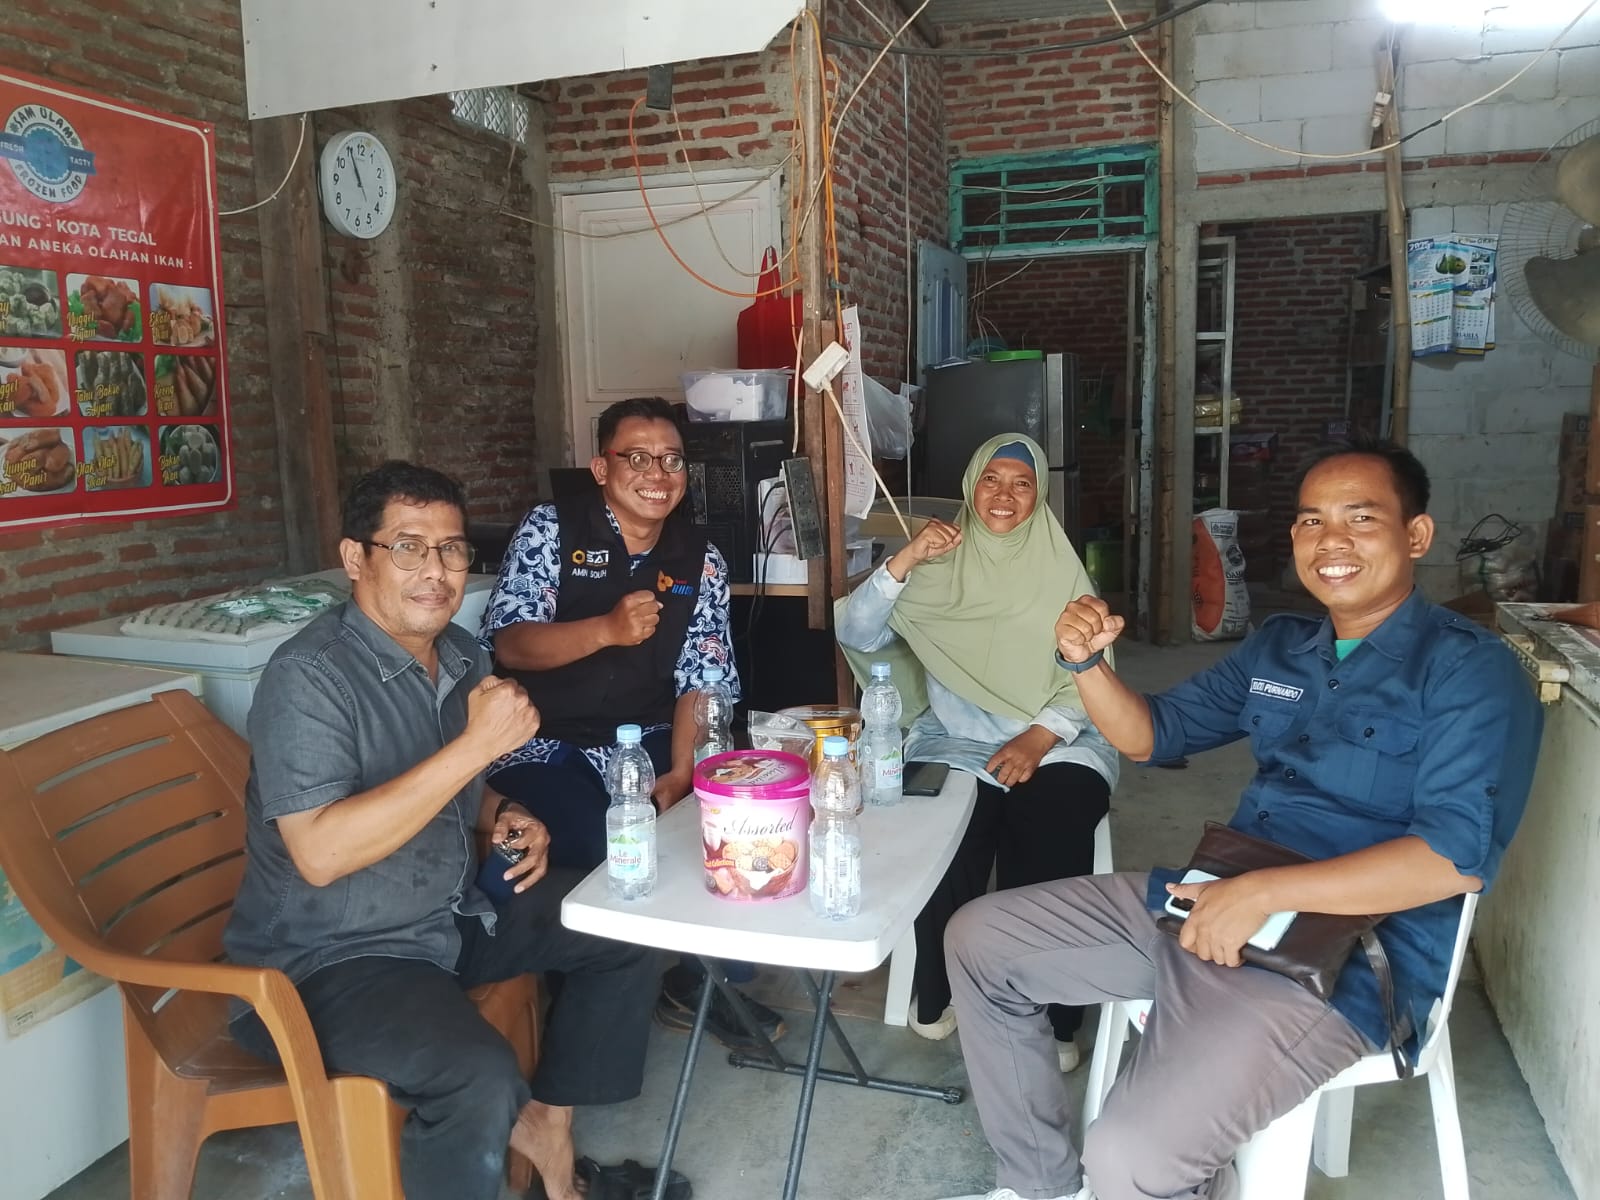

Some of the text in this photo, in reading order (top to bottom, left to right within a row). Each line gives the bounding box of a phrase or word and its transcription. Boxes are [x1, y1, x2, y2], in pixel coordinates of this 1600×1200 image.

[14, 107, 73, 139] SAM ULAM
[0, 141, 24, 153] FRESH
[357, 144, 366, 156] 12
[70, 156, 90, 168] TASTY
[336, 156, 346, 169] 10
[370, 153, 374, 165] 1
[333, 173, 340, 185] 9
[377, 168, 382, 179] 2
[14, 164, 82, 198] FROZEN FOOD
[378, 186, 384, 198] 3
[336, 192, 342, 205] 8
[345, 208, 351, 220] 7
[374, 202, 380, 214] 4
[355, 215, 360, 227] 6
[366, 213, 372, 225] 5
[56, 219, 101, 239] KOTA
[108, 227, 157, 246] TEGAL
[28, 238, 83, 256] ANEKA
[88, 246, 149, 264] OLAHAN
[154, 254, 184, 269] IKAN
[4, 459, 37, 477] Lumpia
[723, 808, 799, 836] Assorted
